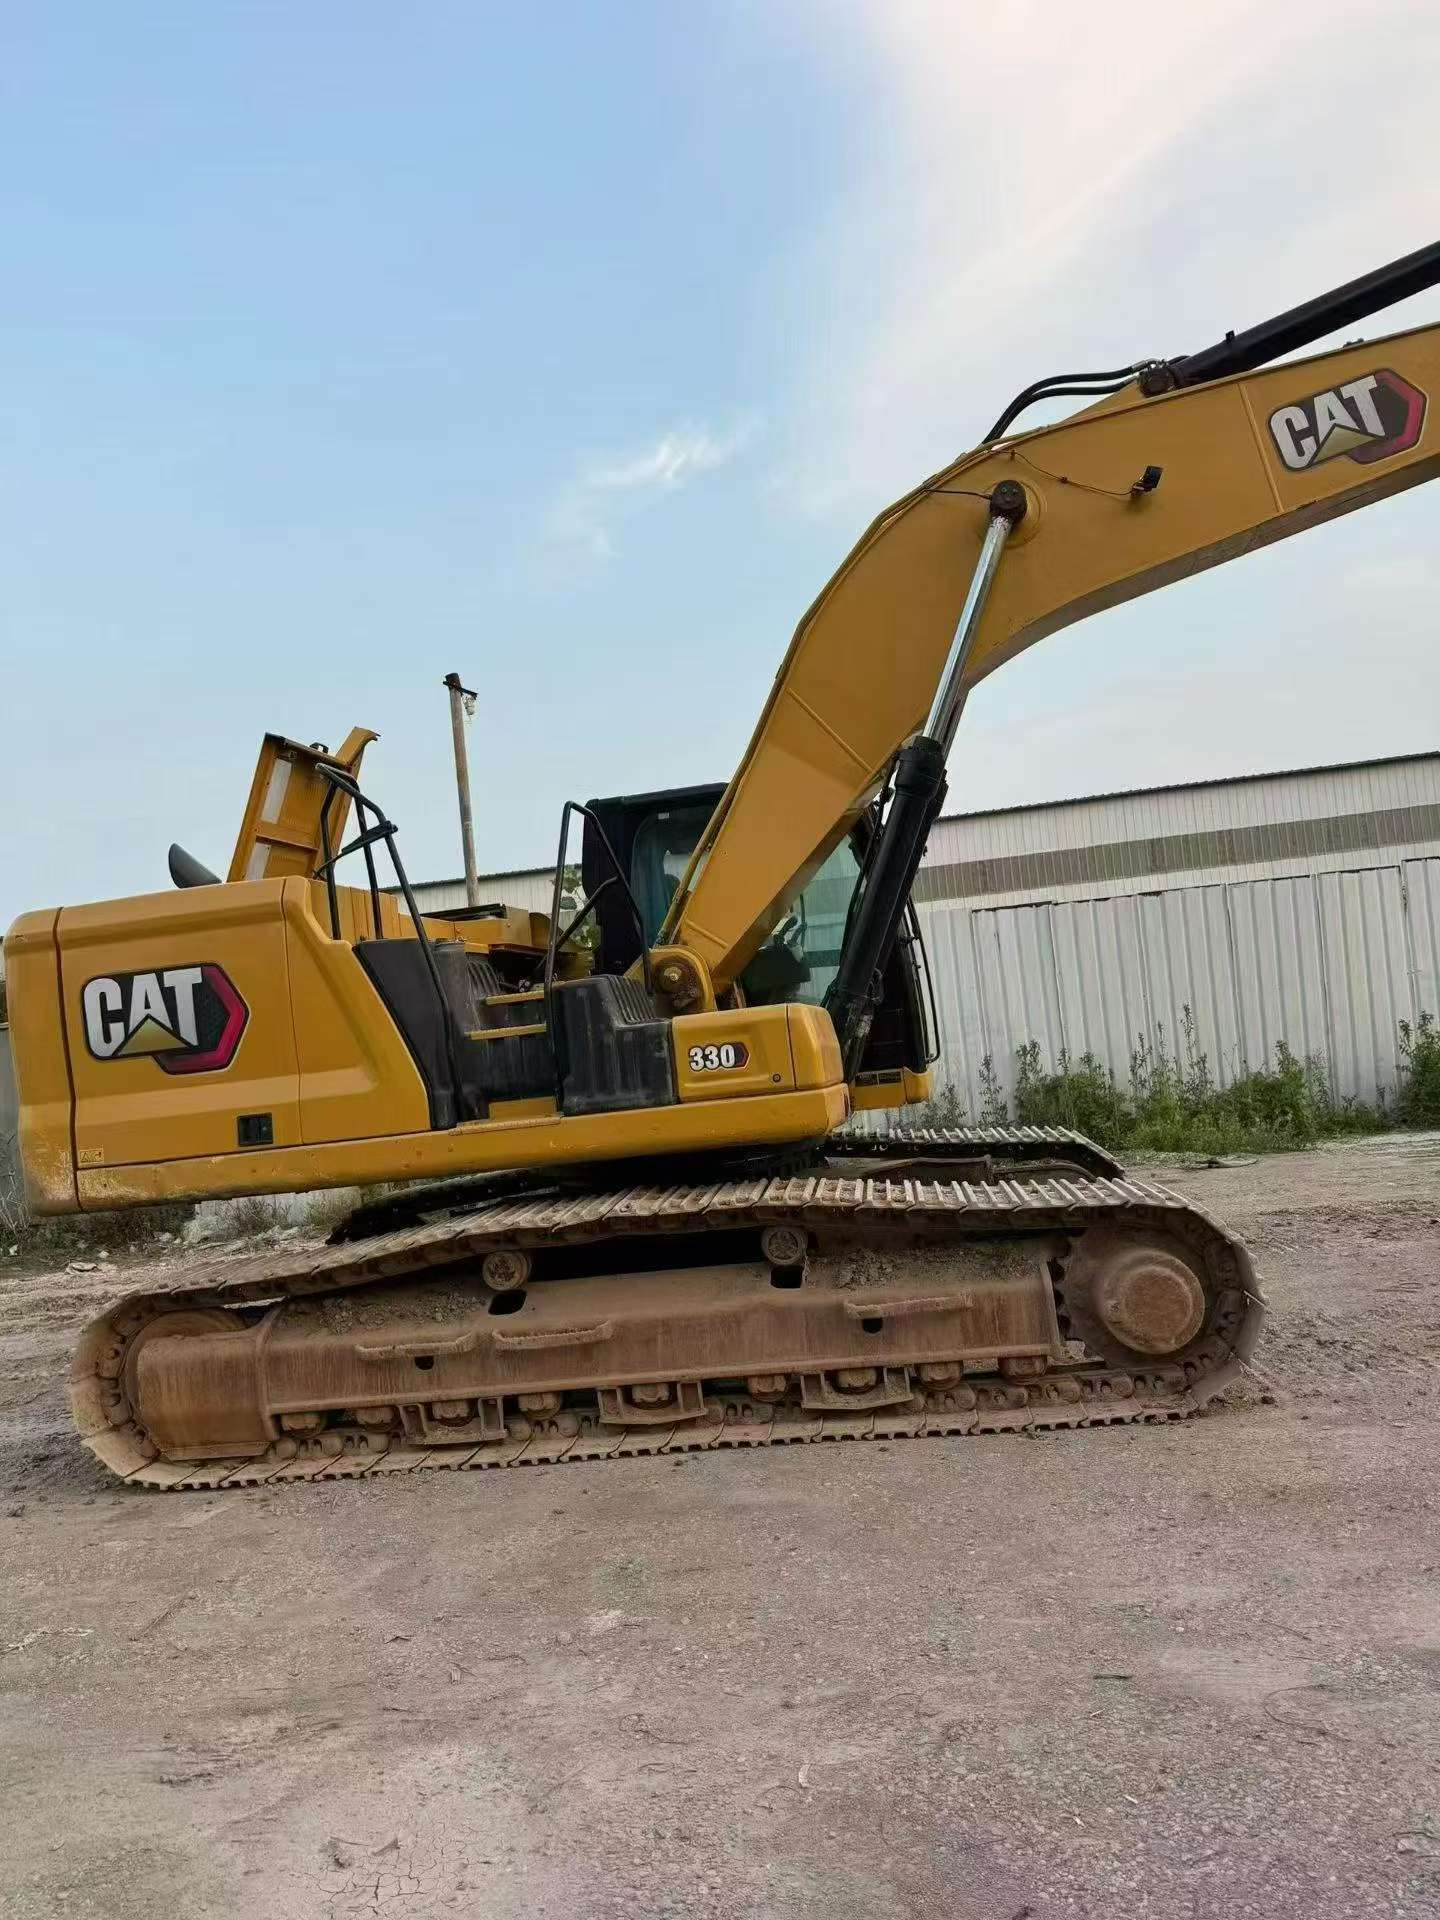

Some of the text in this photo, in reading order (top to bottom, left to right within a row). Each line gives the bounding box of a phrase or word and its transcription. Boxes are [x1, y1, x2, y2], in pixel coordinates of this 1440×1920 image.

[1270, 374, 1386, 469] CAT
[83, 966, 203, 1057] CAT
[689, 1044, 736, 1071] 330
